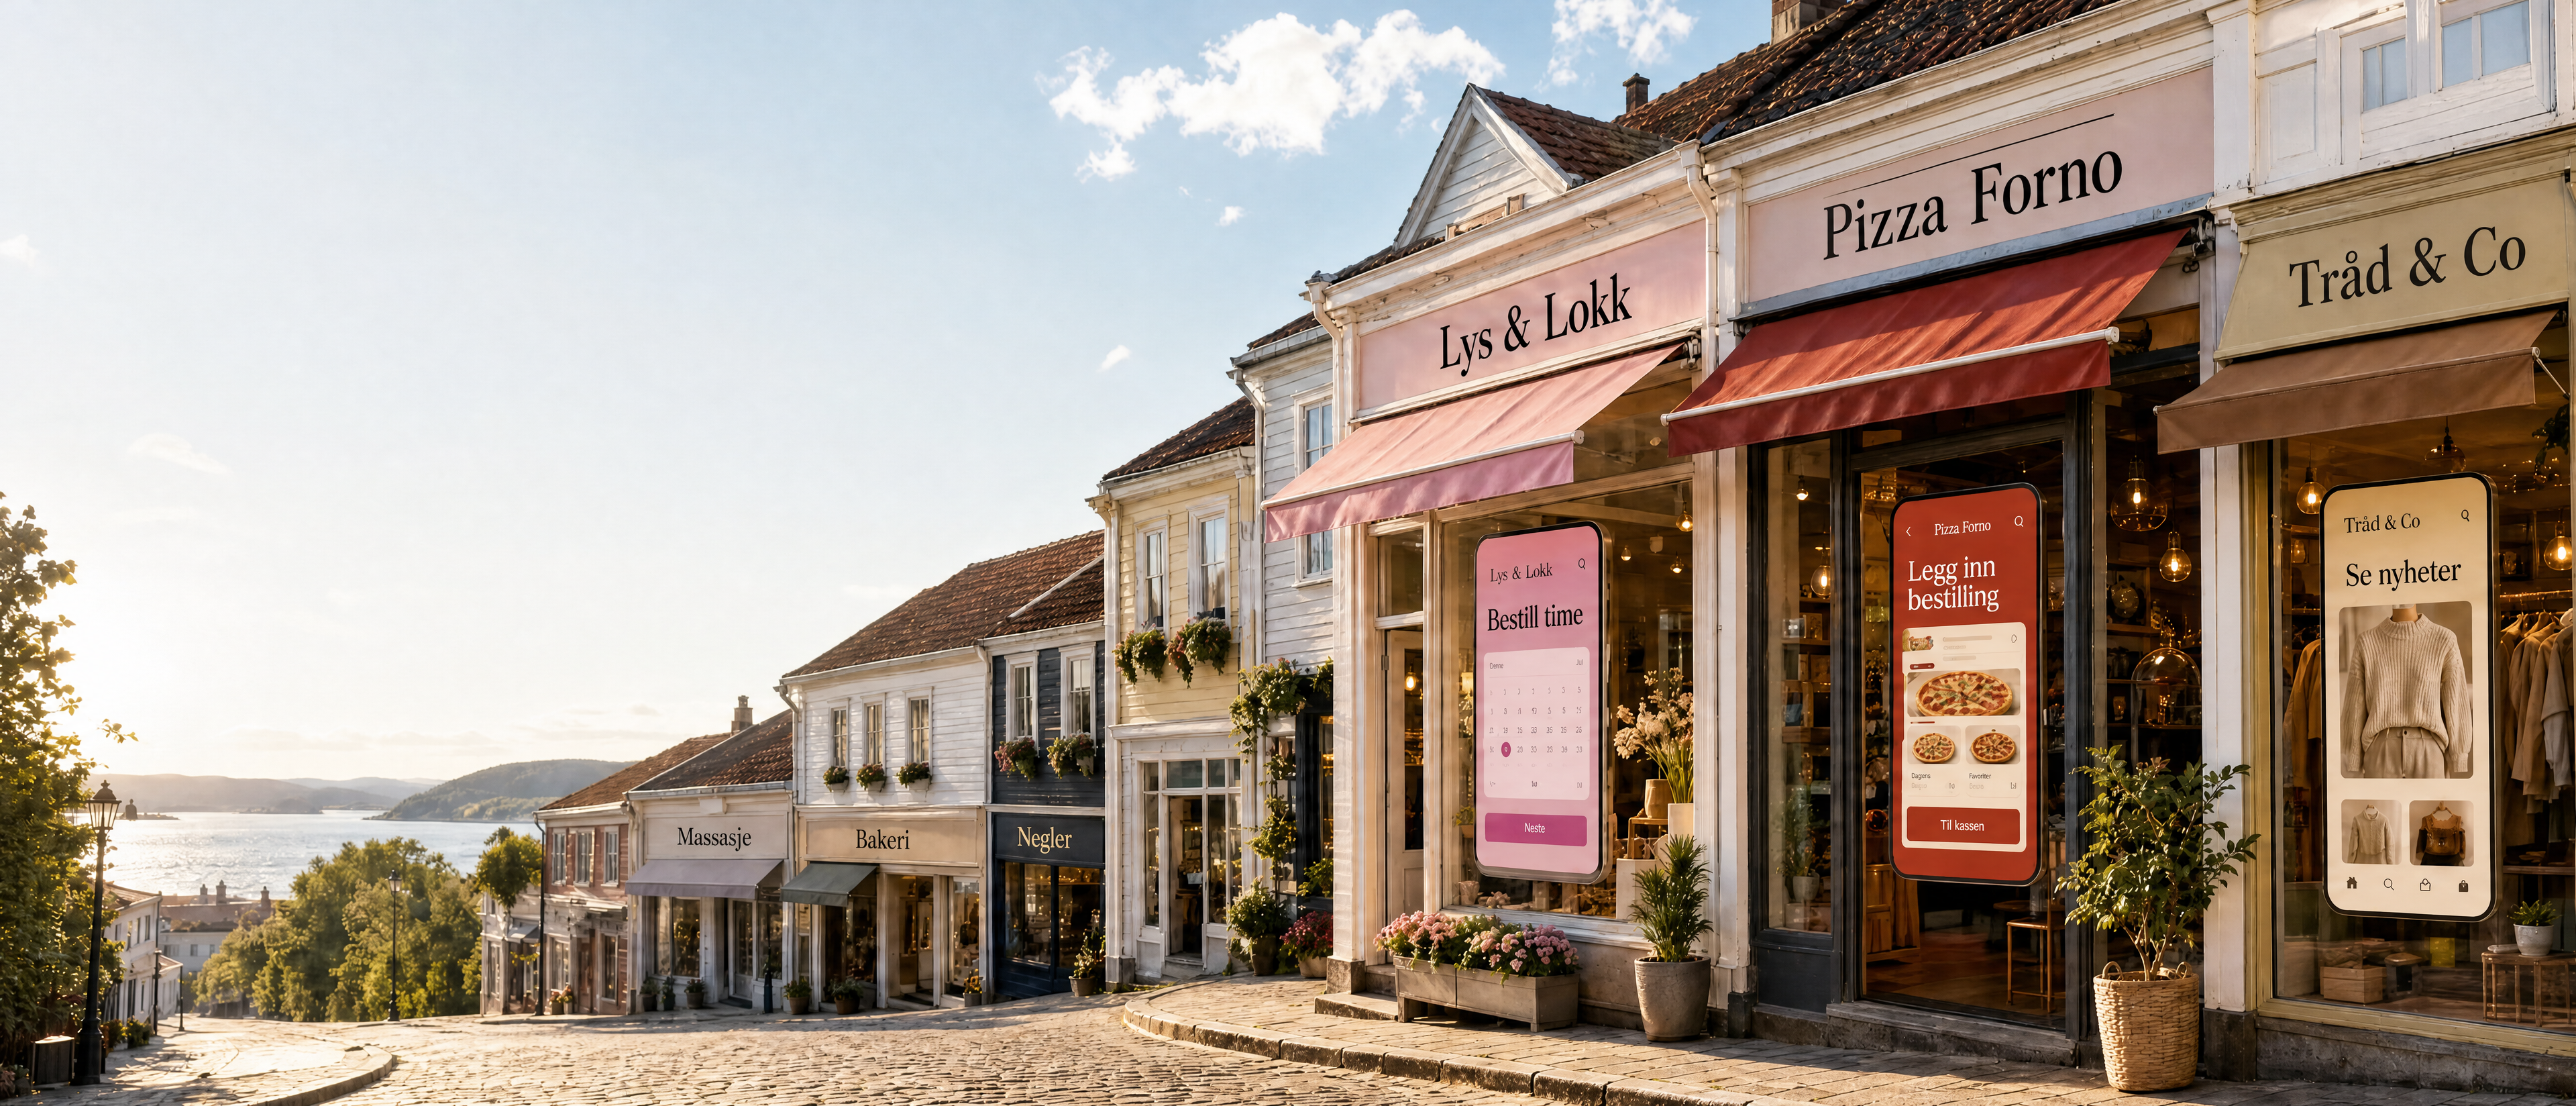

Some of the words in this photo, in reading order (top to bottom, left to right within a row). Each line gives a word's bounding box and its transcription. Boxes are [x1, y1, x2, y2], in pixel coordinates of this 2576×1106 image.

[1823, 195, 1949, 260] Pizza
[1970, 150, 2123, 225] Forno
[2289, 243, 2393, 308] Tråd
[2409, 237, 2447, 287] &
[2463, 226, 2526, 276] Co
[1440, 324, 1493, 377] Lys
[1504, 305, 1531, 352] &
[1544, 272, 1633, 342] Lokk
[1934, 523, 1960, 536] Pizza
[1962, 521, 1991, 534] Forno
[2343, 514, 2381, 534] Tråd
[2384, 515, 2397, 530] &
[2401, 513, 2420, 529] Co
[1490, 568, 1508, 585] Lys
[1512, 566, 1521, 580] &
[1525, 562, 1553, 579] Lokk
[1908, 560, 1958, 586] Legg
[1963, 556, 1996, 579] inn
[2346, 563, 2372, 587] Se
[2378, 558, 2462, 592] nyheter
[1908, 585, 1999, 612] bestilling
[1487, 604, 1539, 632] Bestill
[1544, 604, 1583, 627] time
[1911, 772, 1931, 781] Dagens
[1524, 822, 1546, 834] Neste
[1940, 819, 1952, 831] Til
[1954, 819, 1984, 832] kassen
[677, 827, 751, 852] Massasje
[855, 829, 910, 850] Bakeri
[1017, 826, 1073, 854] Negler
